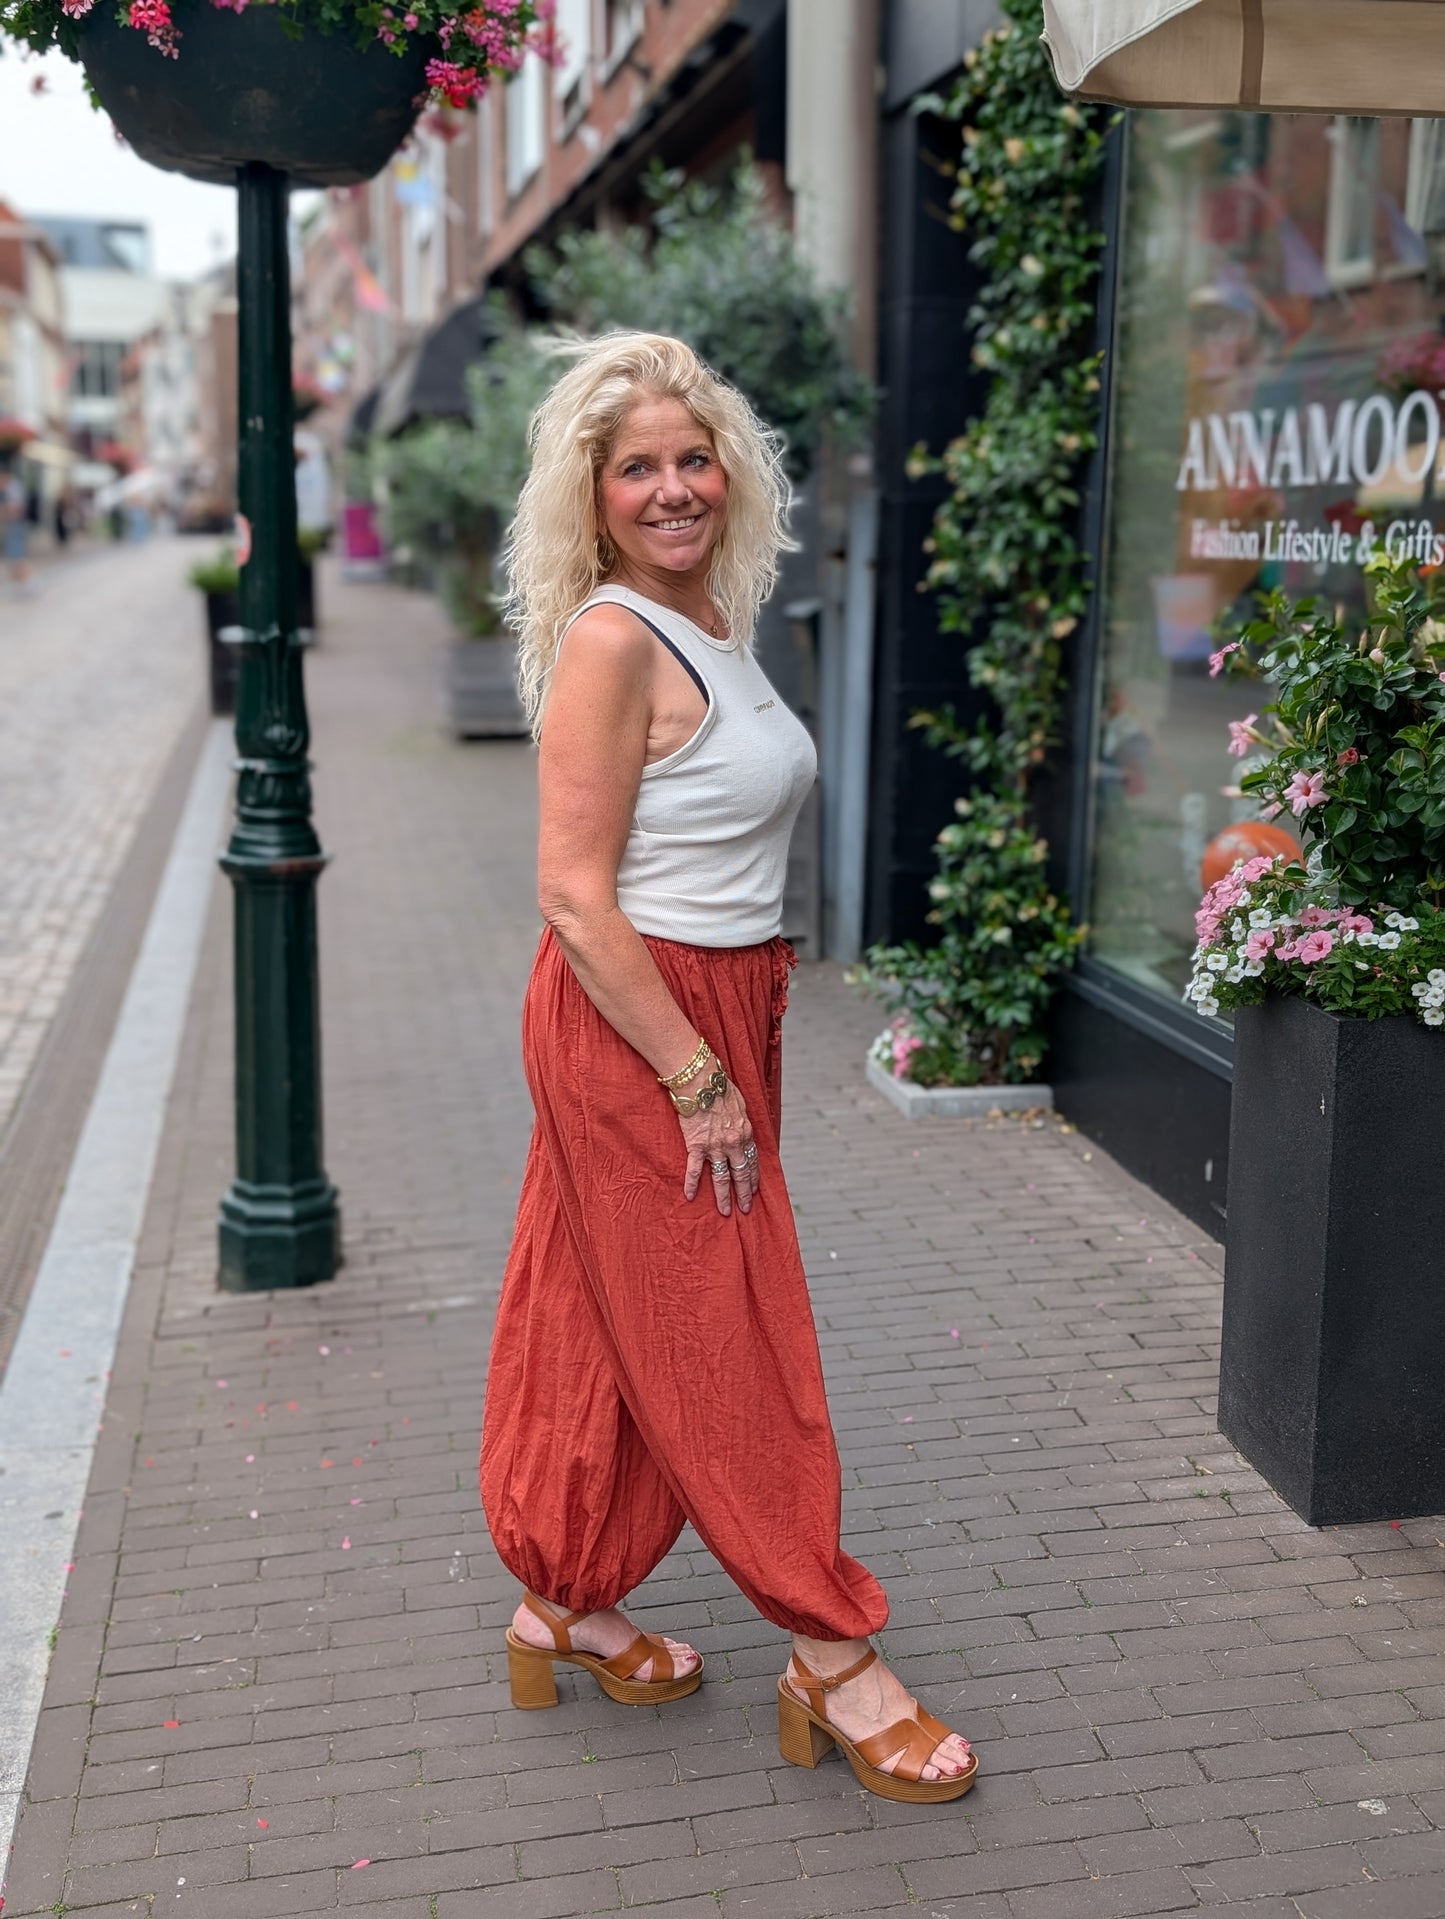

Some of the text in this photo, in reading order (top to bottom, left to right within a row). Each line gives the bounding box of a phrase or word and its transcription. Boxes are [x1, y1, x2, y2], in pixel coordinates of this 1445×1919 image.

[1175, 389, 1445, 491] ANNAMOO
[1190, 518, 1445, 575] Fashion Lifestyle & Gifts
